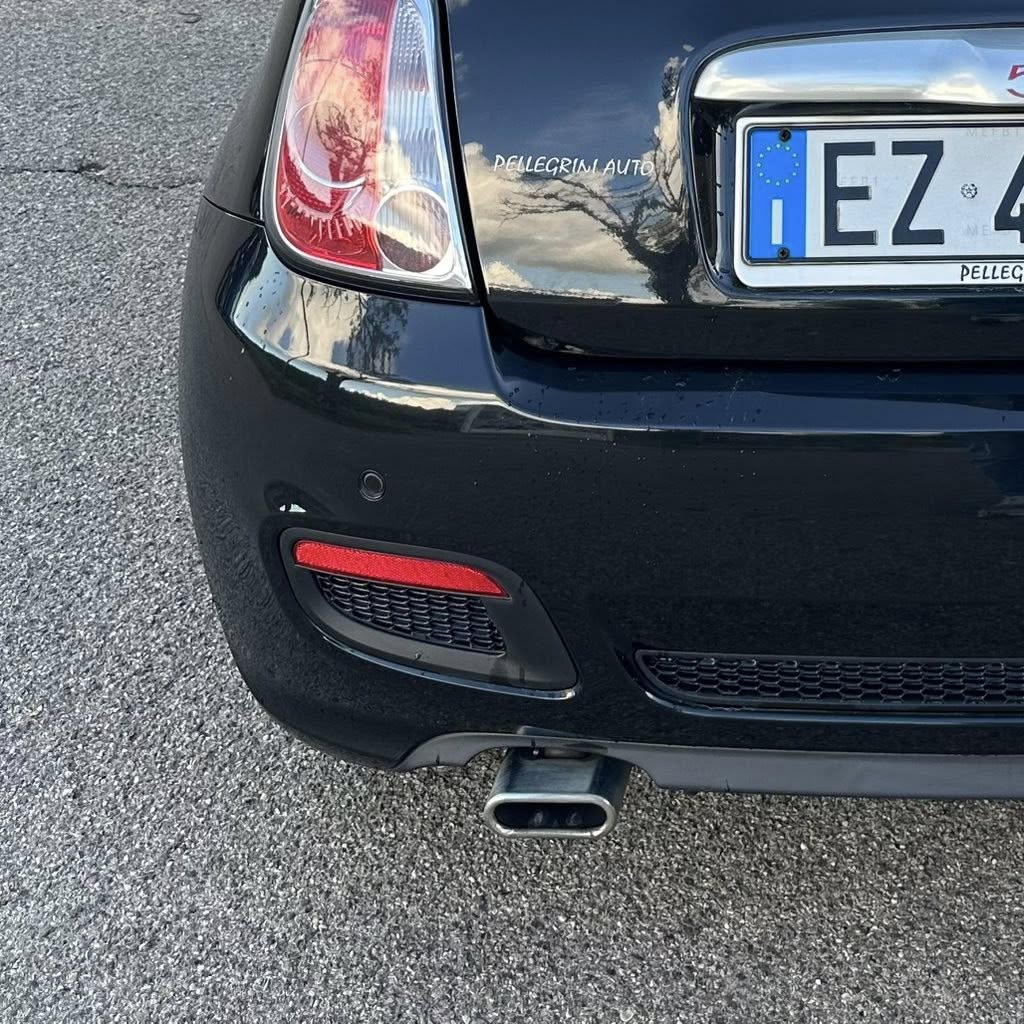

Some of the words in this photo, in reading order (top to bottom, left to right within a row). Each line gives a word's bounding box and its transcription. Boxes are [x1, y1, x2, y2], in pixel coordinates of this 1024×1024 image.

[493, 154, 599, 176] PELLEGRINI
[602, 158, 655, 176] AUTO
[823, 139, 945, 246] EZ
